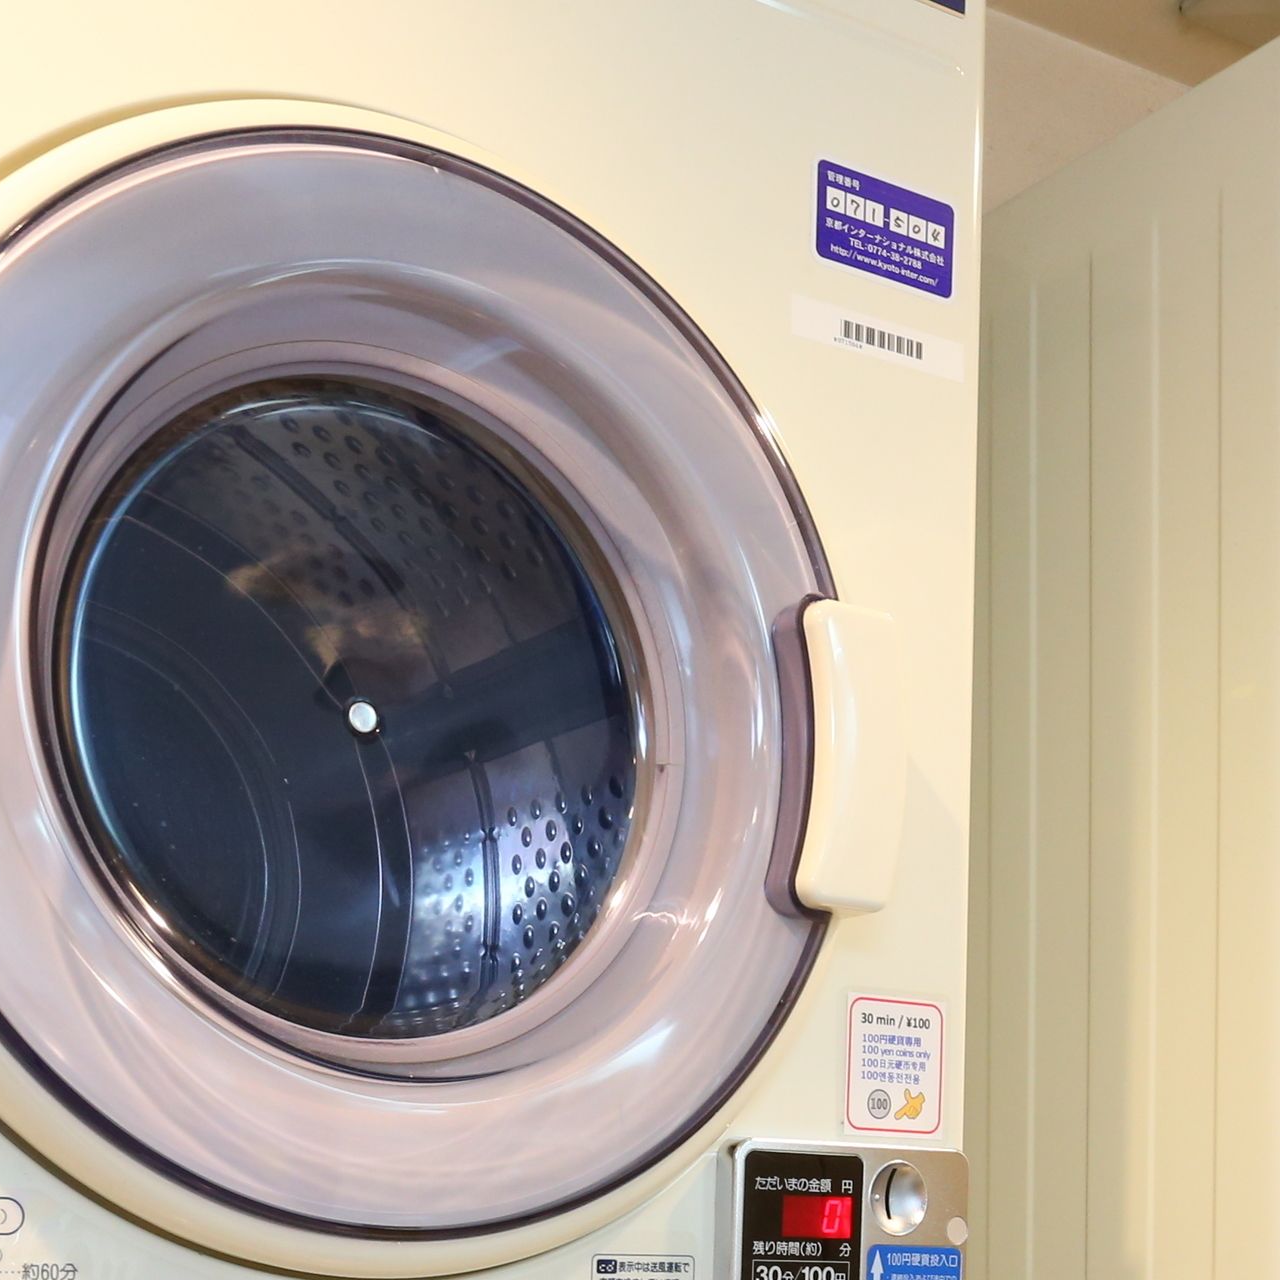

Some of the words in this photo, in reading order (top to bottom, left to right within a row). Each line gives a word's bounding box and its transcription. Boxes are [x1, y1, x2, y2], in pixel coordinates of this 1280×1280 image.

[827, 170, 860, 191] 管理番号
[861, 1012, 874, 1024] 30
[876, 1014, 895, 1026] min
[906, 1016, 930, 1030] ¥100
[862, 1044, 879, 1055] 100
[880, 1047, 894, 1057] yen
[895, 1048, 914, 1058] coins
[916, 1050, 931, 1060] only
[870, 1098, 888, 1110] 100
[755, 1176, 832, 1193] ただいまの金額
[841, 1180, 853, 1194] 円
[822, 1200, 841, 1233] 0
[752, 1240, 822, 1256] 残り時間(約)
[839, 1243, 852, 1257] 分
[887, 1252, 958, 1268] 100円硬貨投入口
[21, 1263, 78, 1280] 約60分
